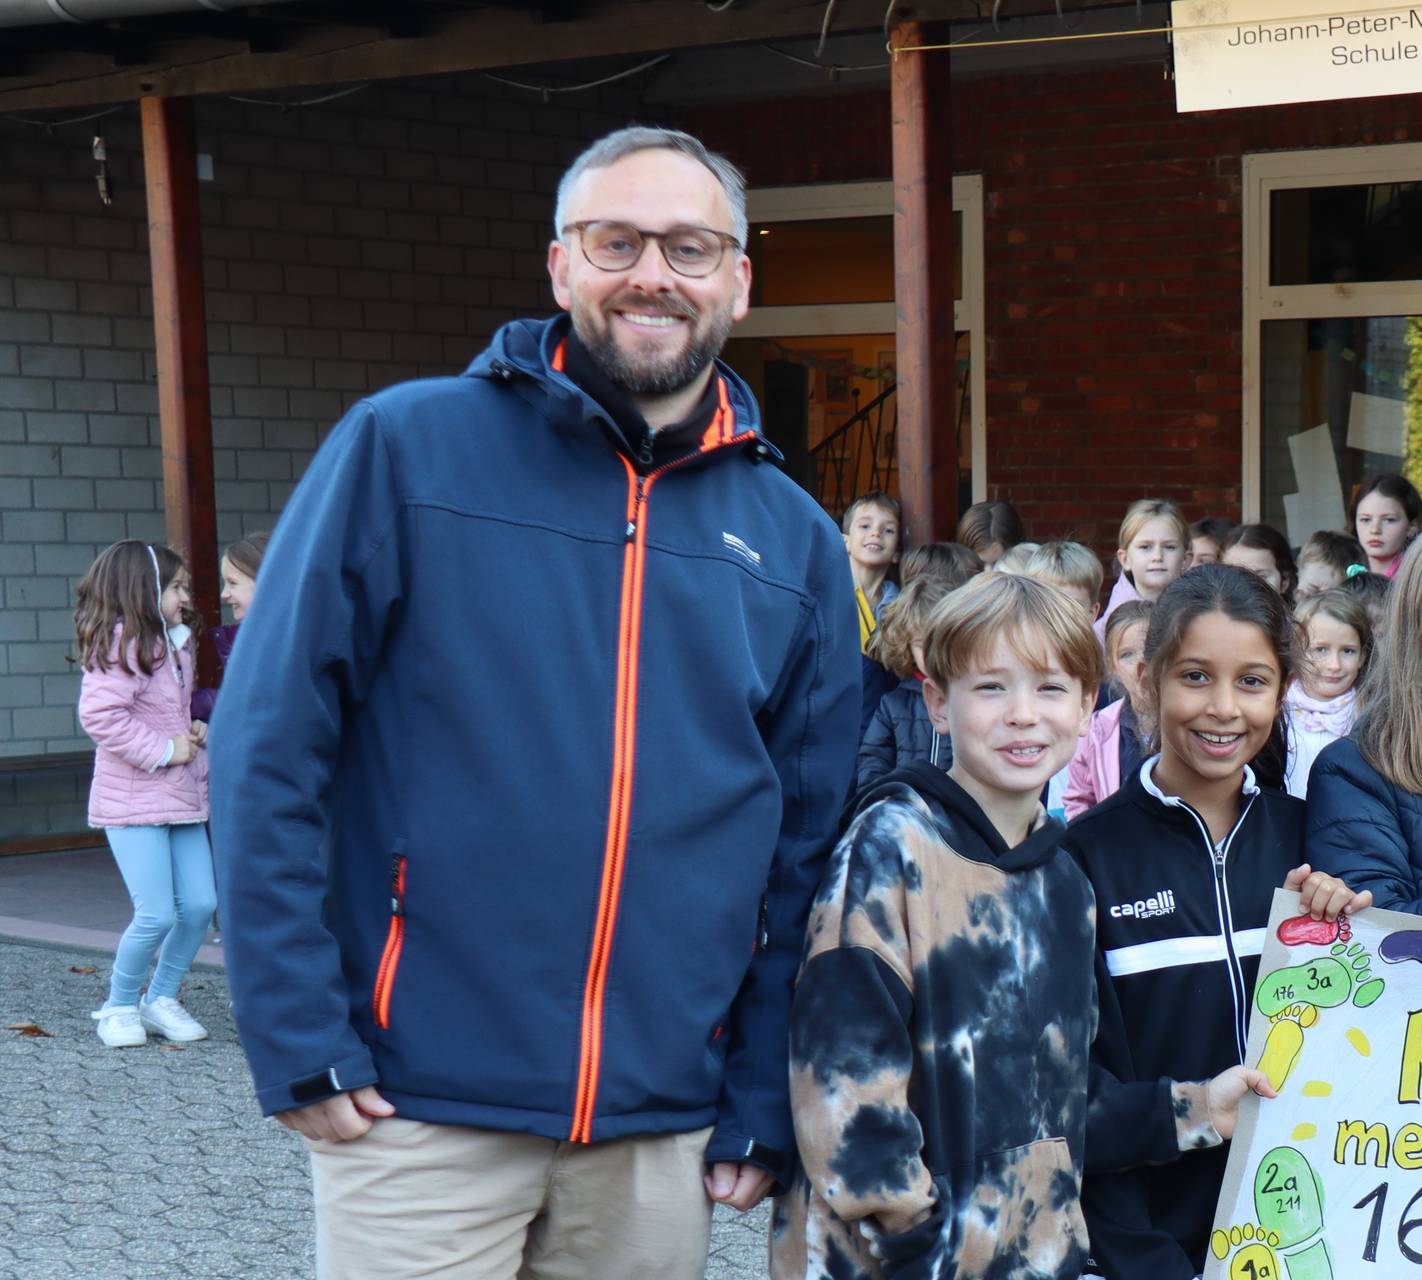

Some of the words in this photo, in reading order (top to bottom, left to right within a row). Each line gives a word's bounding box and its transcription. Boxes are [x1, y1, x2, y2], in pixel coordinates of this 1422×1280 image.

[1331, 41, 1418, 66] Schule
[1110, 889, 1175, 918] capelli
[1141, 906, 1176, 918] SPORT
[1307, 967, 1332, 990] 3a
[1272, 984, 1294, 1000] 176
[1261, 1163, 1298, 1194] 2a
[1276, 1194, 1301, 1214] 211
[1240, 1259, 1270, 1280] 1a
